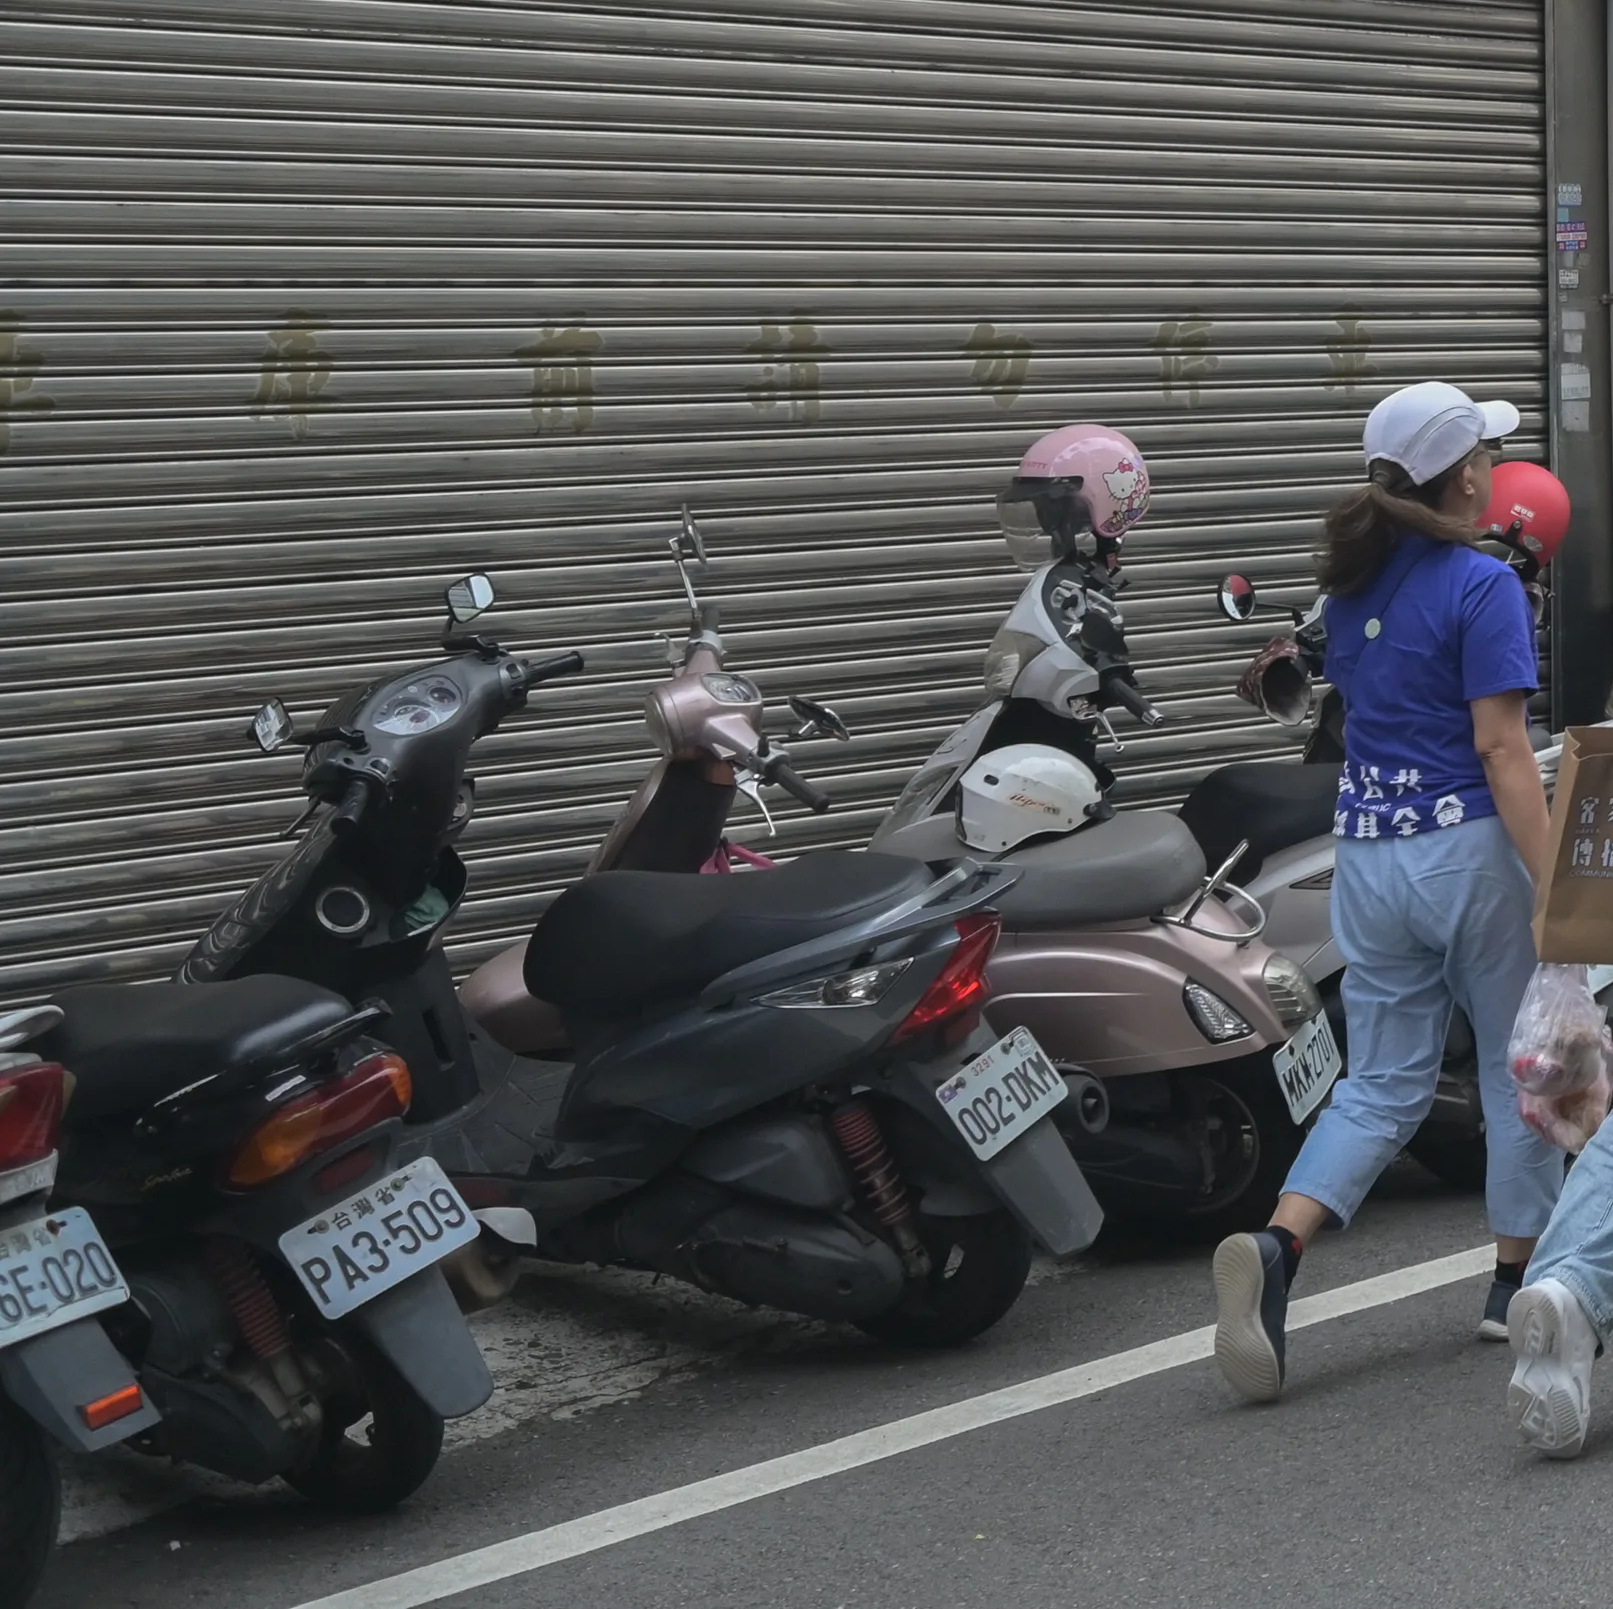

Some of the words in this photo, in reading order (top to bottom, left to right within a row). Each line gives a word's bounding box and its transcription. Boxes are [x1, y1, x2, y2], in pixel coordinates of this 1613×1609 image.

[300, 1187, 467, 1305] PA3-509
[331, 1186, 396, 1231] 台灣省
